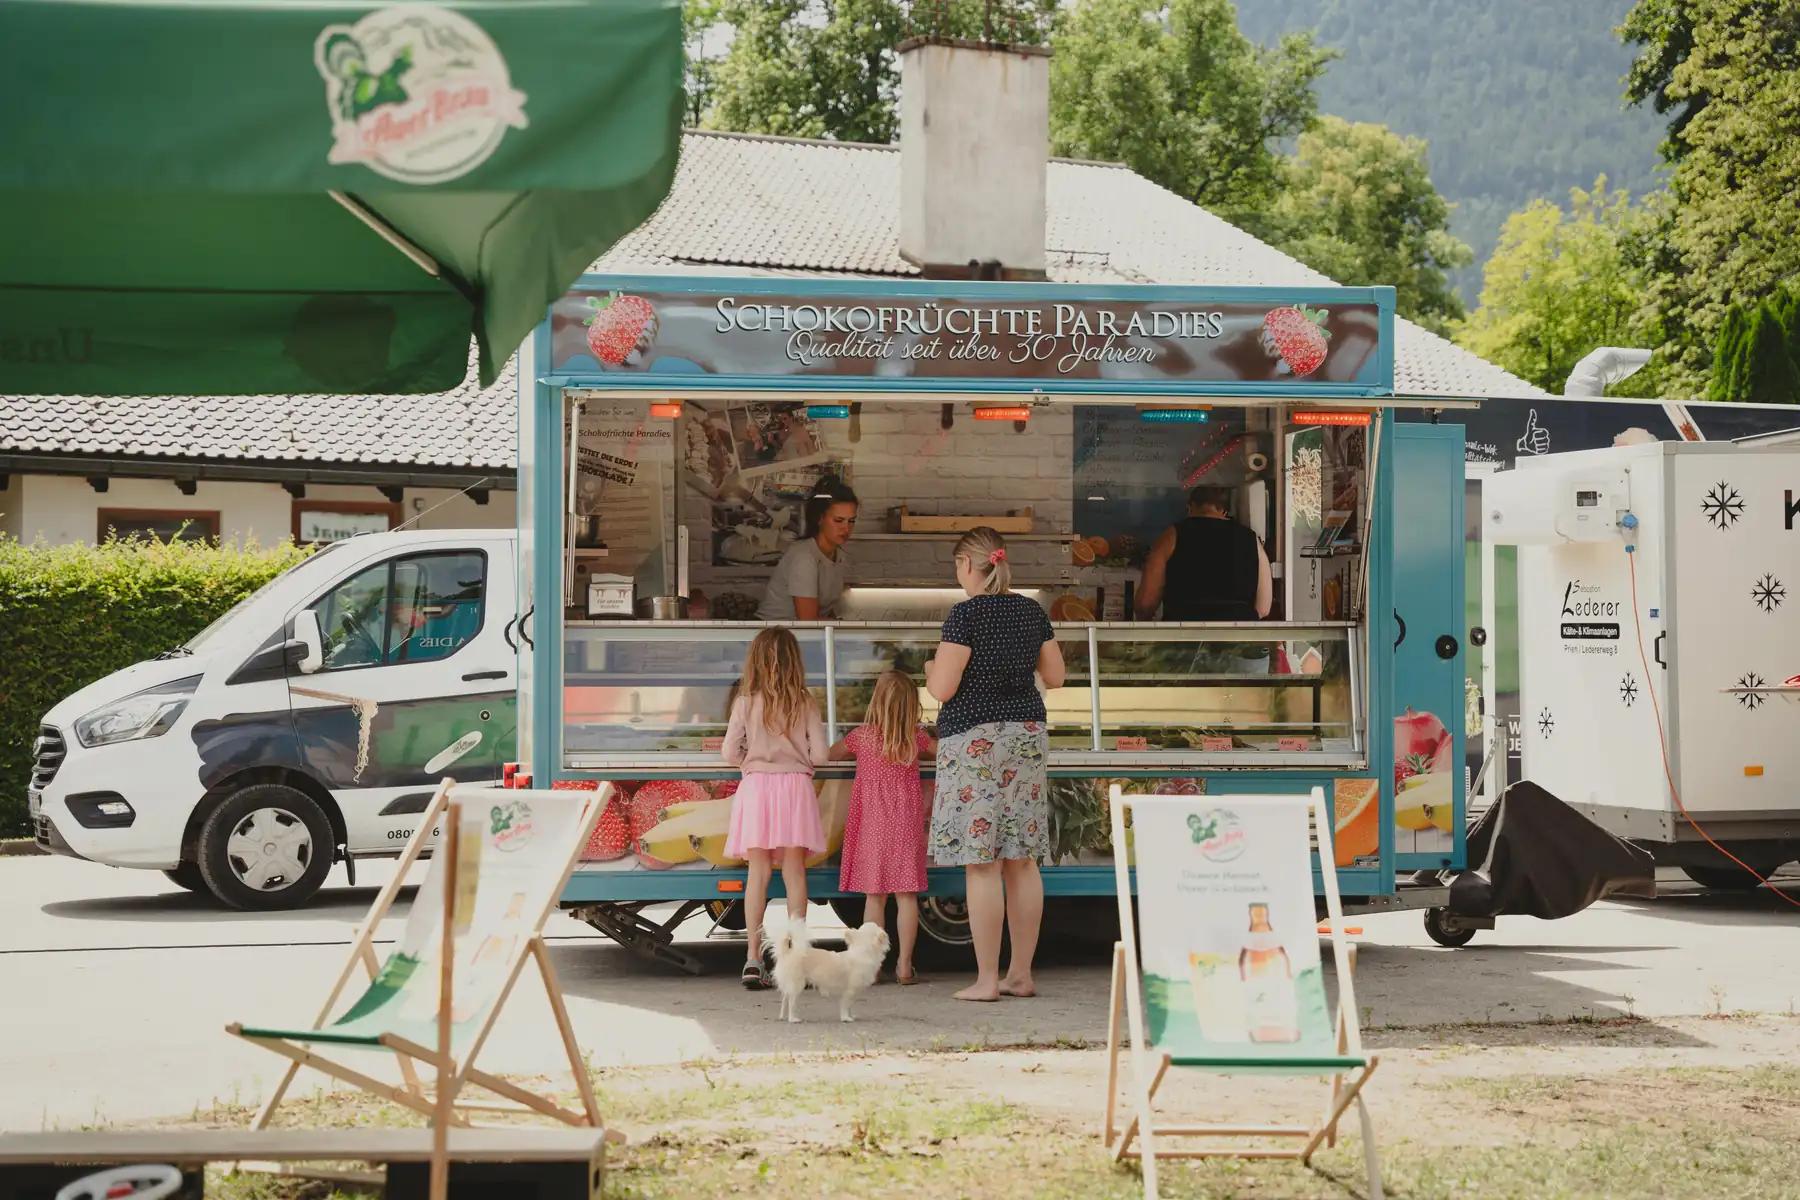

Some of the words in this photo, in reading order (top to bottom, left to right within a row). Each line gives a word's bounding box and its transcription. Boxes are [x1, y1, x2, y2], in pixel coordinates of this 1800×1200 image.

[715, 297, 1043, 336] SCHOKOFRÜCHTE
[1053, 303, 1224, 338] PARADIES
[785, 329, 895, 366] Qualität
[901, 336, 942, 361] seit
[948, 333, 1001, 362] über
[1008, 333, 1057, 364] 30
[1056, 331, 1158, 375] Jahren
[1561, 581, 1620, 618] Lederer
